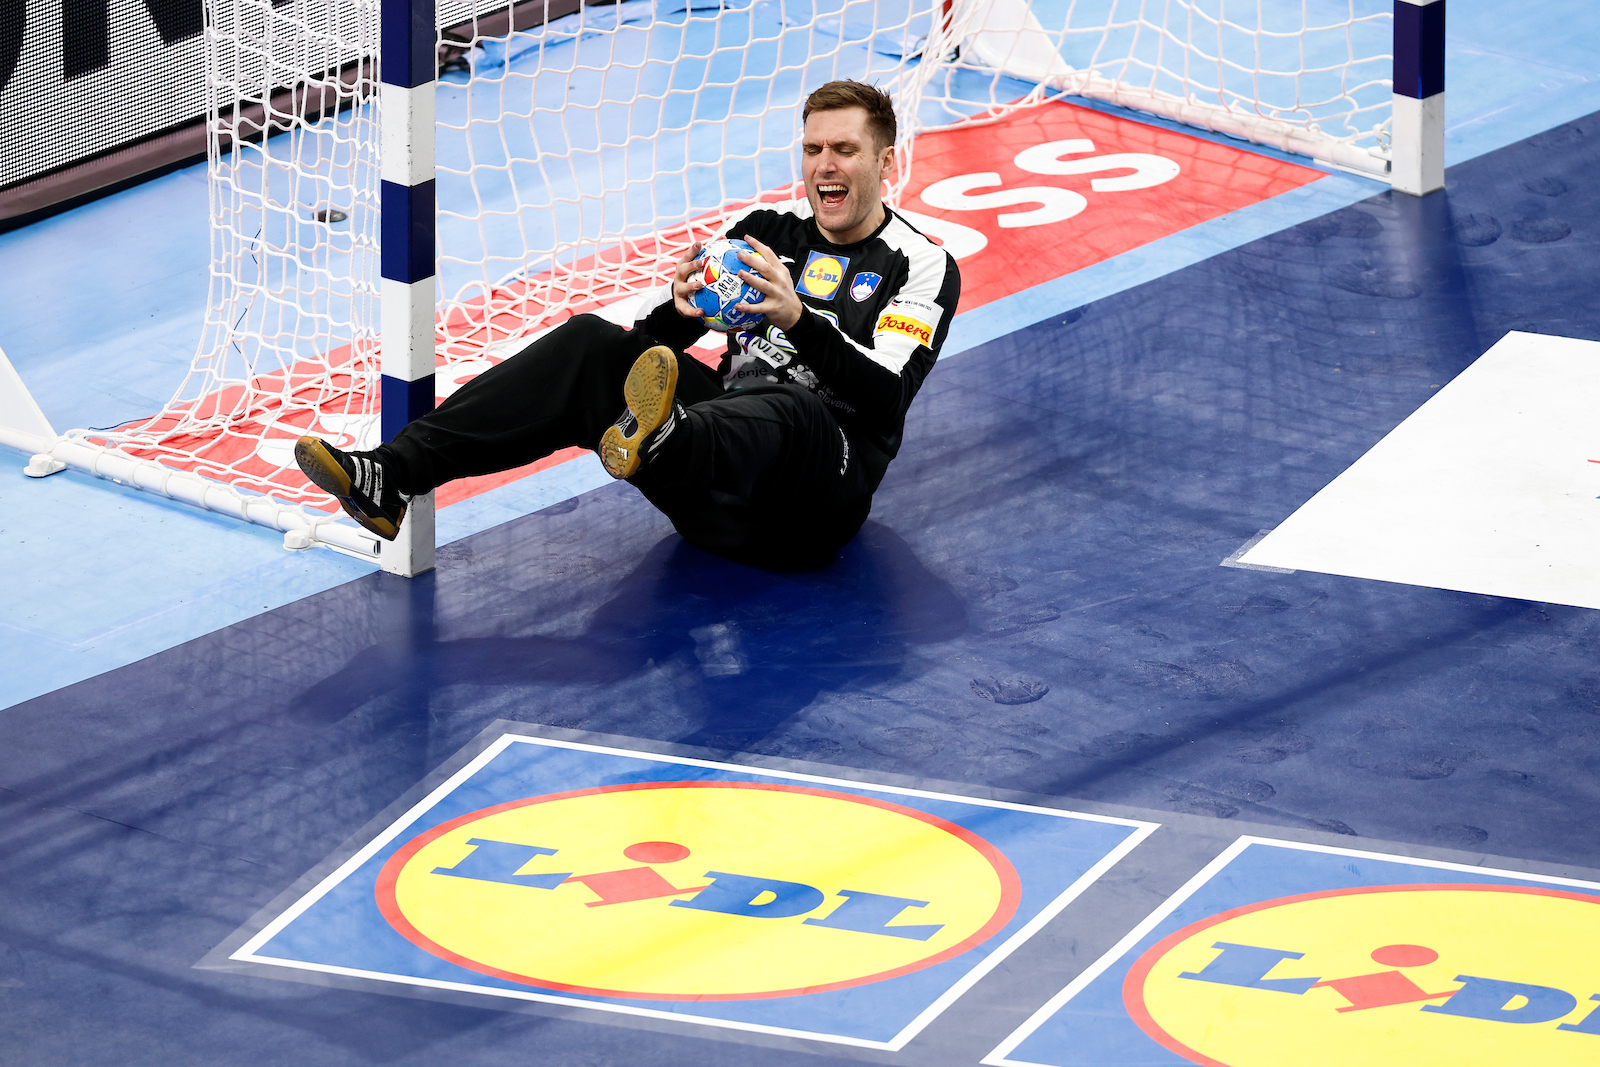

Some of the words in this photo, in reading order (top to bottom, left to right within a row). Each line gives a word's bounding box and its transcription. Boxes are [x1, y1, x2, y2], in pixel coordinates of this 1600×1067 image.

[718, 275, 734, 295] PLAY
[878, 316, 930, 342] Josera
[751, 337, 785, 363] NLB
